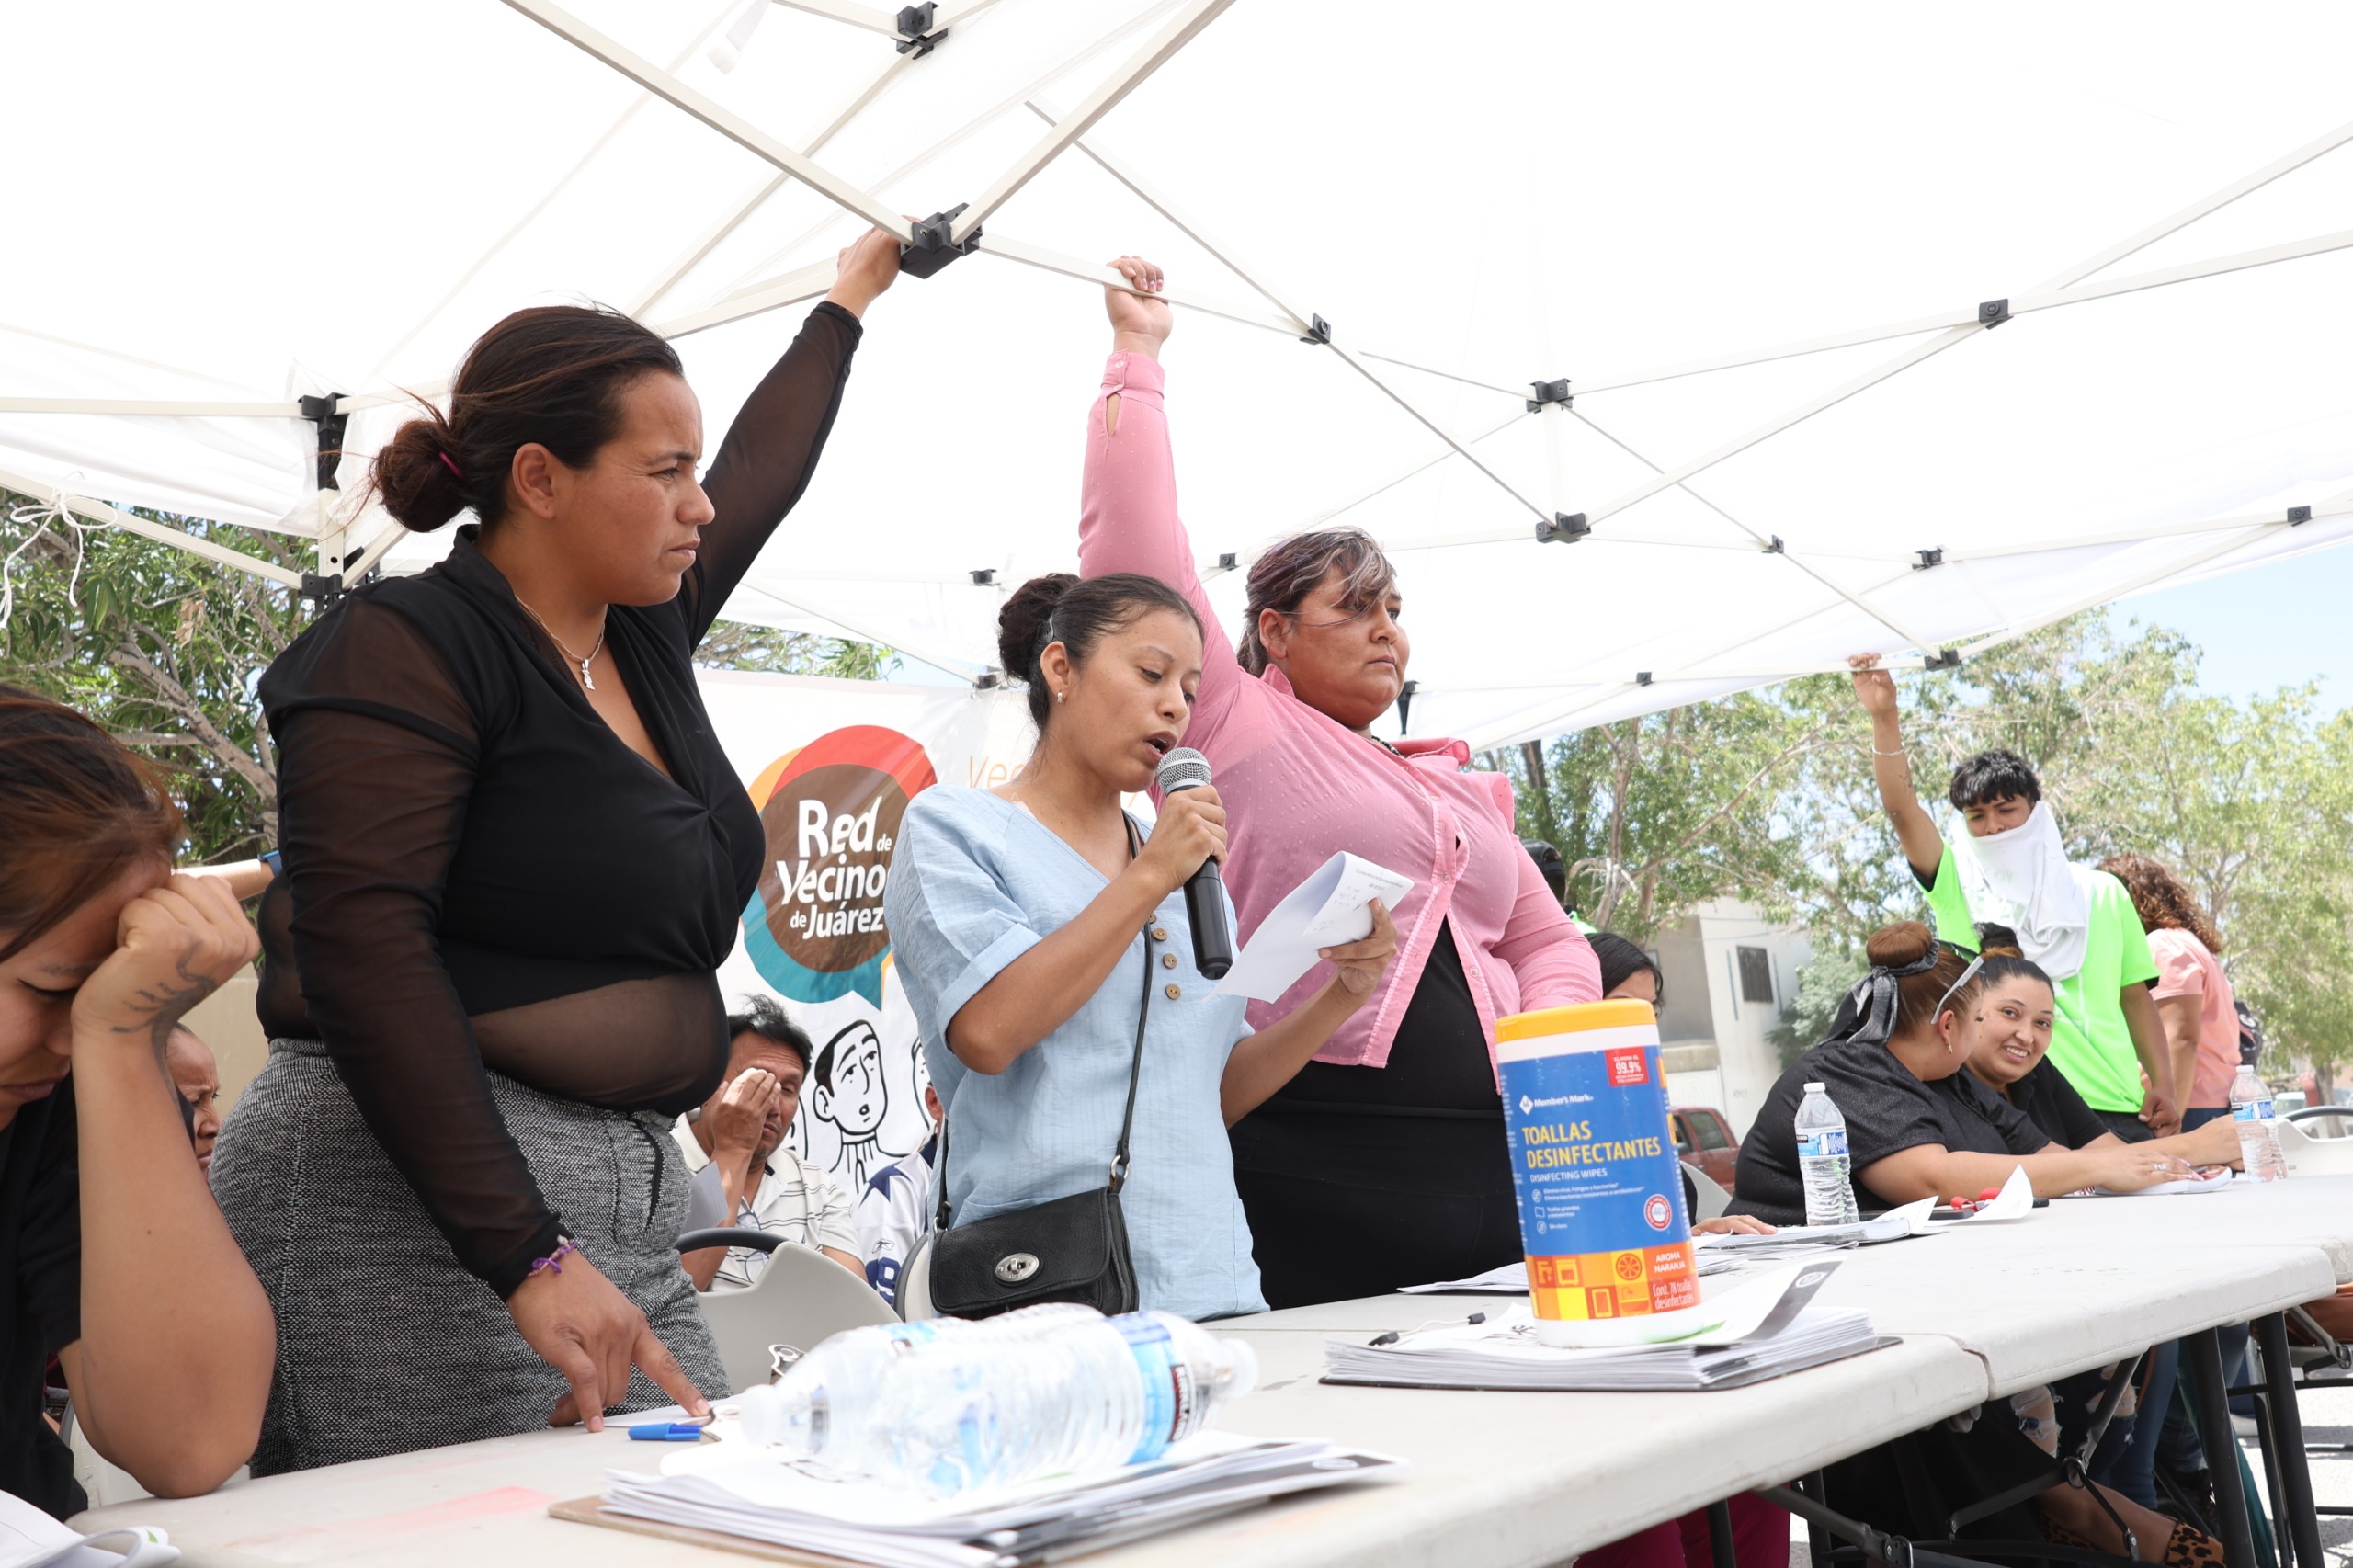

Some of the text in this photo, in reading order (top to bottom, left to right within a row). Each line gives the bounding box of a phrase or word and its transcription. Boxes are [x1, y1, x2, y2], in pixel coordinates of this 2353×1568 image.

[798, 796, 892, 858] Red de
[790, 901, 884, 940] de Juárez
[1615, 1061, 1642, 1074] 99.9%
[1534, 1095, 1569, 1108] Member's
[1522, 1120, 1592, 1145] TOALLAS
[1526, 1137, 1662, 1169] DESINFECTANTES
[1529, 1169, 1580, 1183] DISINFECTING
[1581, 1167, 1608, 1178] WIPES
[1655, 1251, 1681, 1263] AROMA
[1654, 1260, 1686, 1273] NARANJA
[1652, 1283, 1670, 1297] Cont.
[1677, 1278, 1692, 1292] toallas
[1654, 1292, 1694, 1310] desinfectantes
